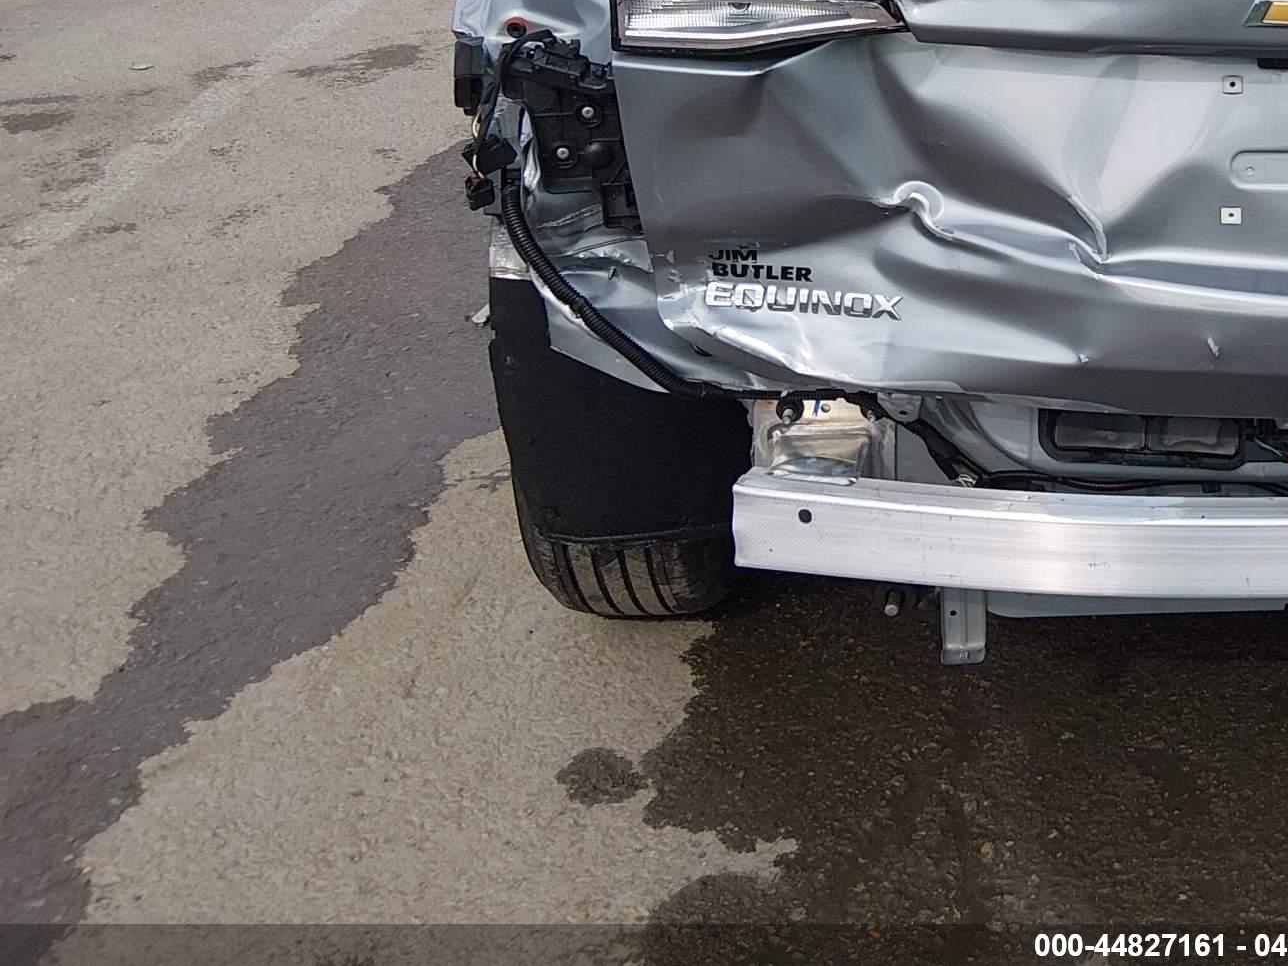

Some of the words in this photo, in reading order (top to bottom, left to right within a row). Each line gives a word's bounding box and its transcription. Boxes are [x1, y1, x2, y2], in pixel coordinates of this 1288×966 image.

[709, 248, 758, 263] JIM
[711, 262, 813, 282] BUTLER
[705, 282, 903, 320] EQUINOX
